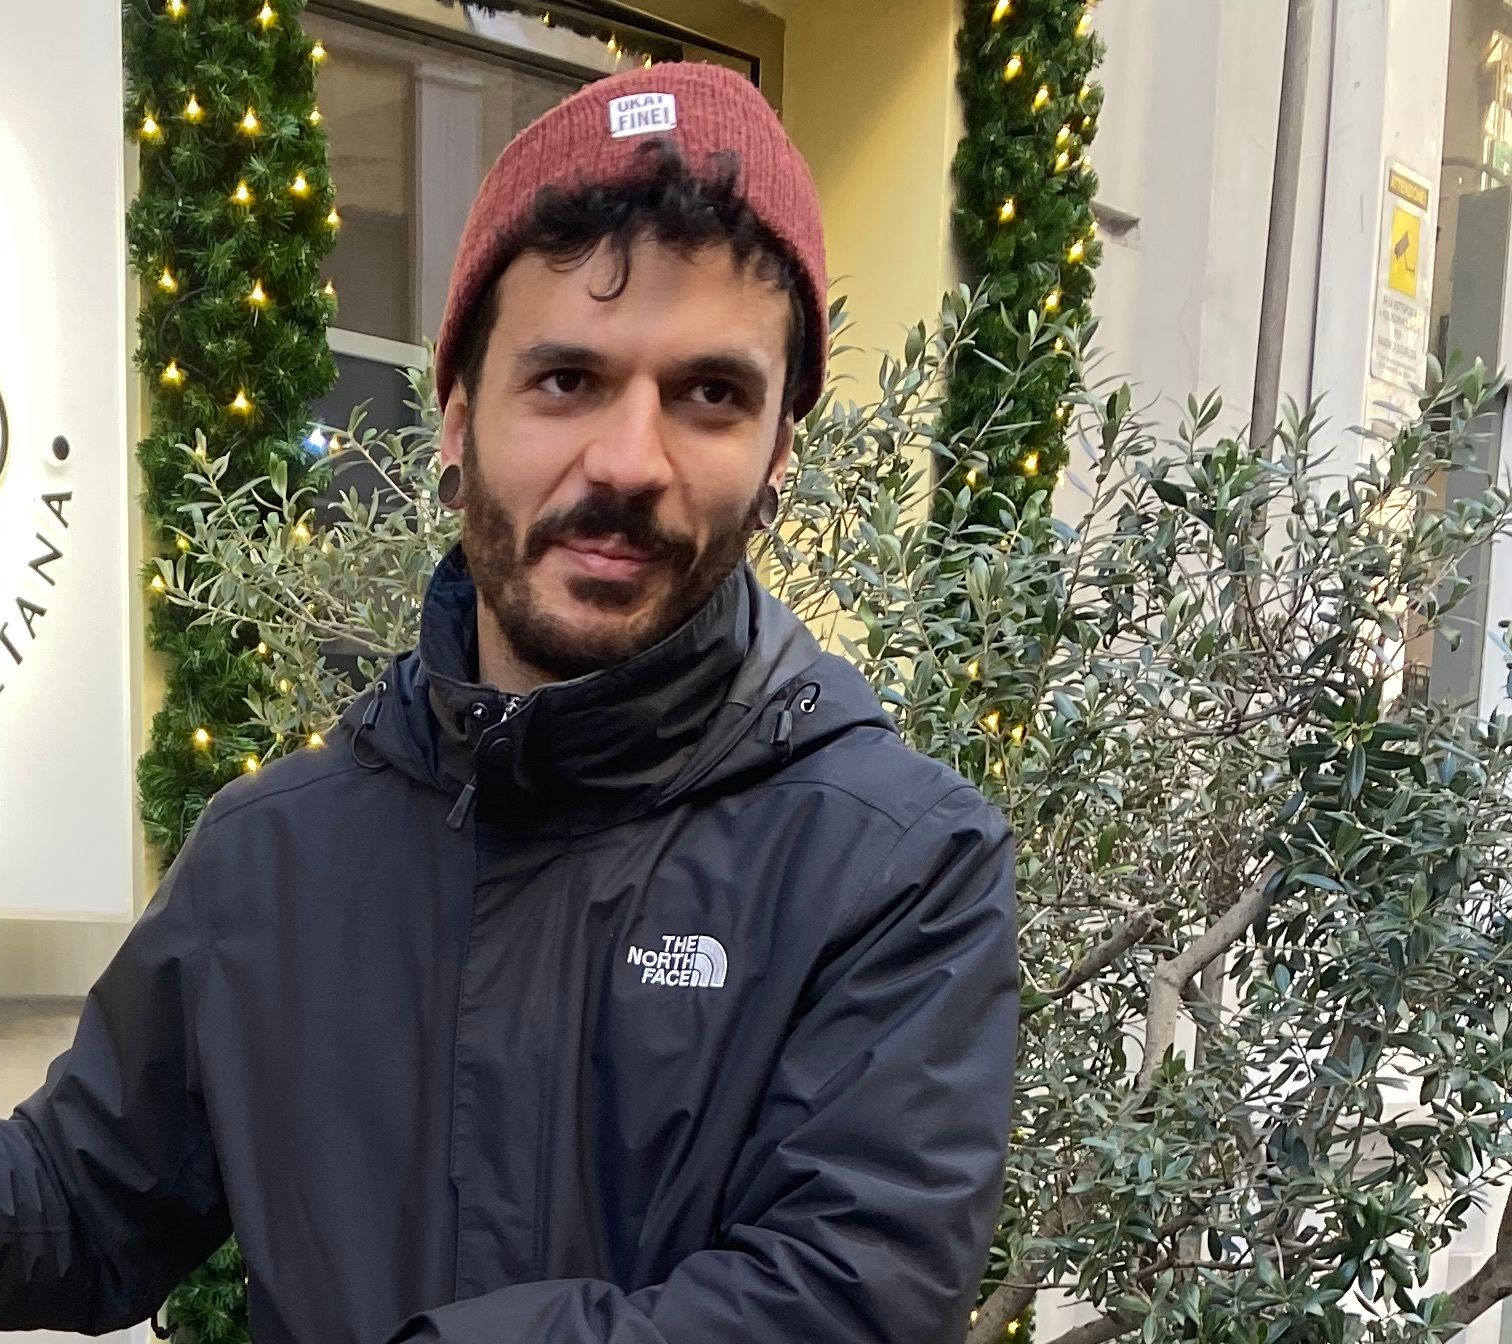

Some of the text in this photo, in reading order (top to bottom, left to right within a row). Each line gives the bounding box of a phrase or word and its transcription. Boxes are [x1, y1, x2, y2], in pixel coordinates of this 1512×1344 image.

[618, 107, 669, 131] FINE!
[662, 935, 699, 953] THE
[627, 945, 695, 970] NORTH
[641, 967, 691, 987] FACE
